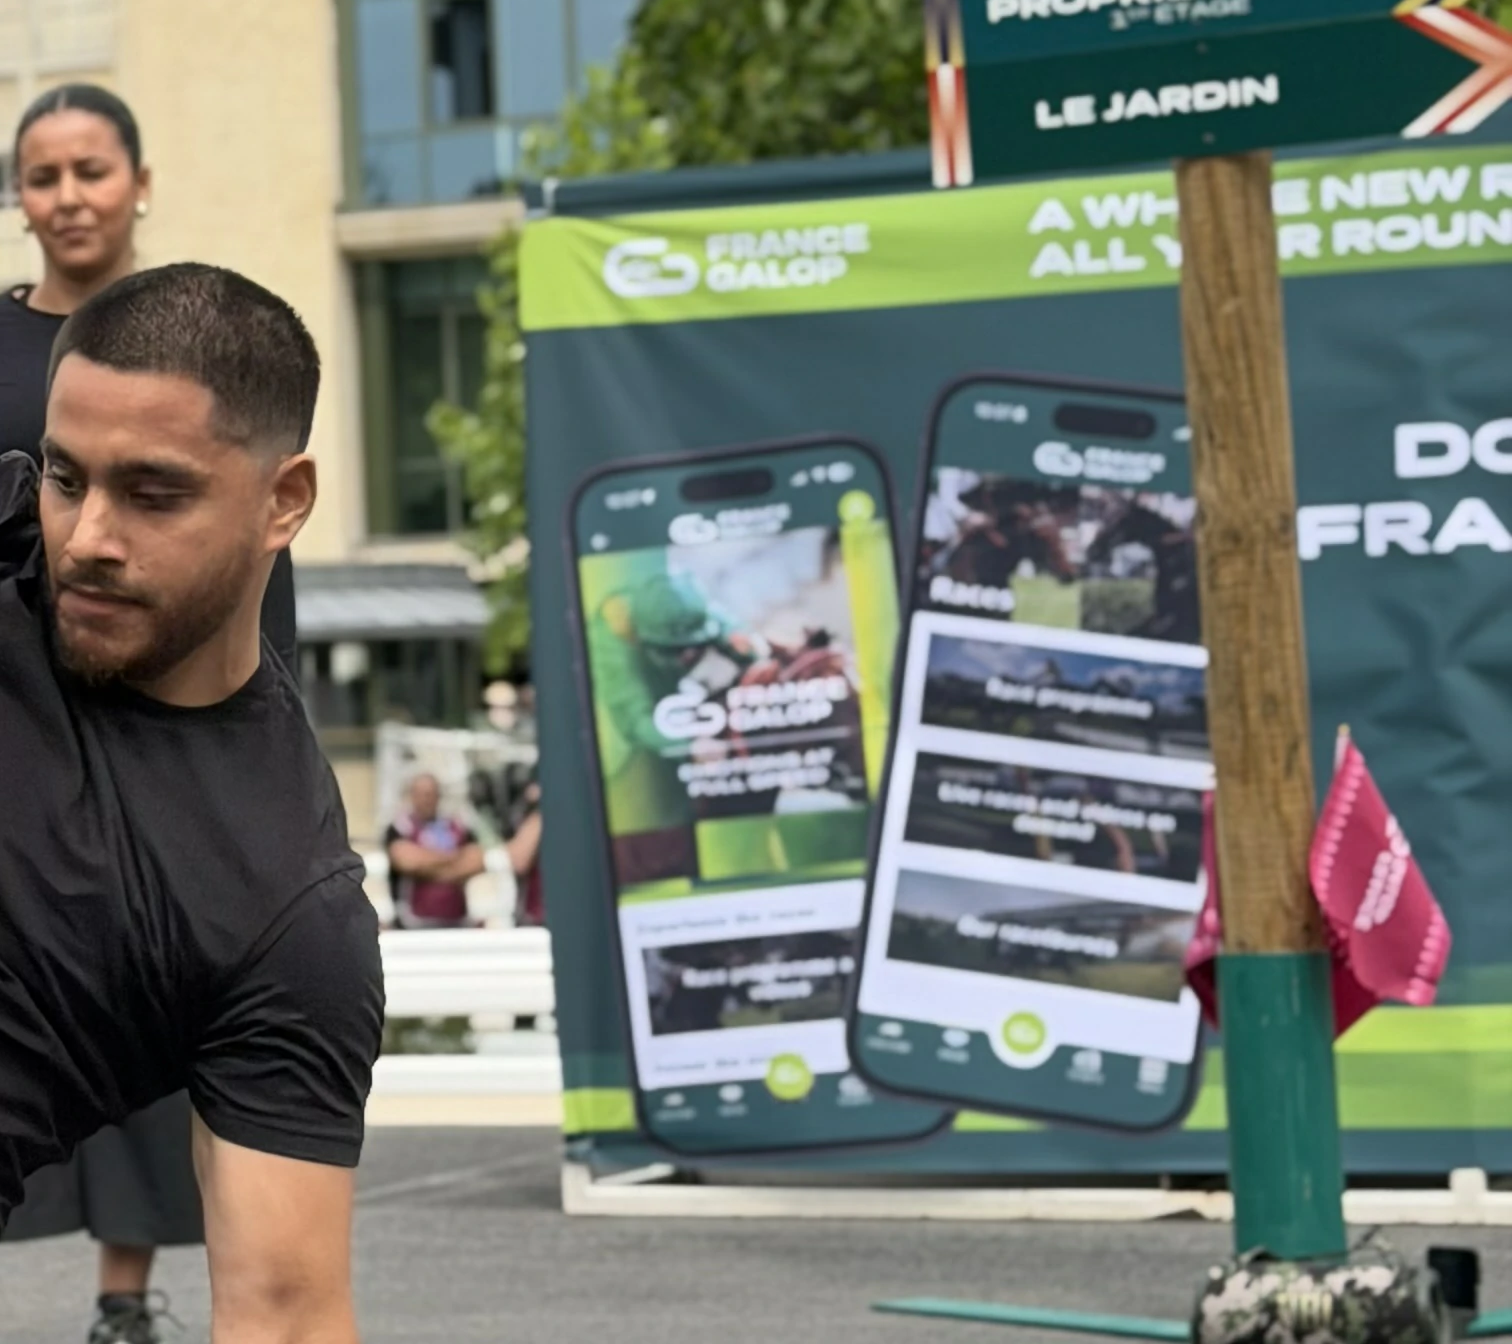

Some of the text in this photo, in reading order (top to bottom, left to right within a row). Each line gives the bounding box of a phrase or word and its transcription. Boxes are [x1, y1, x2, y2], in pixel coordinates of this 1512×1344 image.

[1034, 74, 1280, 129] LE JARDIN
[1028, 198, 1074, 233] A
[1320, 166, 1470, 211] NEW
[705, 222, 871, 263] FRANCE
[1029, 238, 1146, 278] ALL
[704, 255, 849, 292] GALOP
